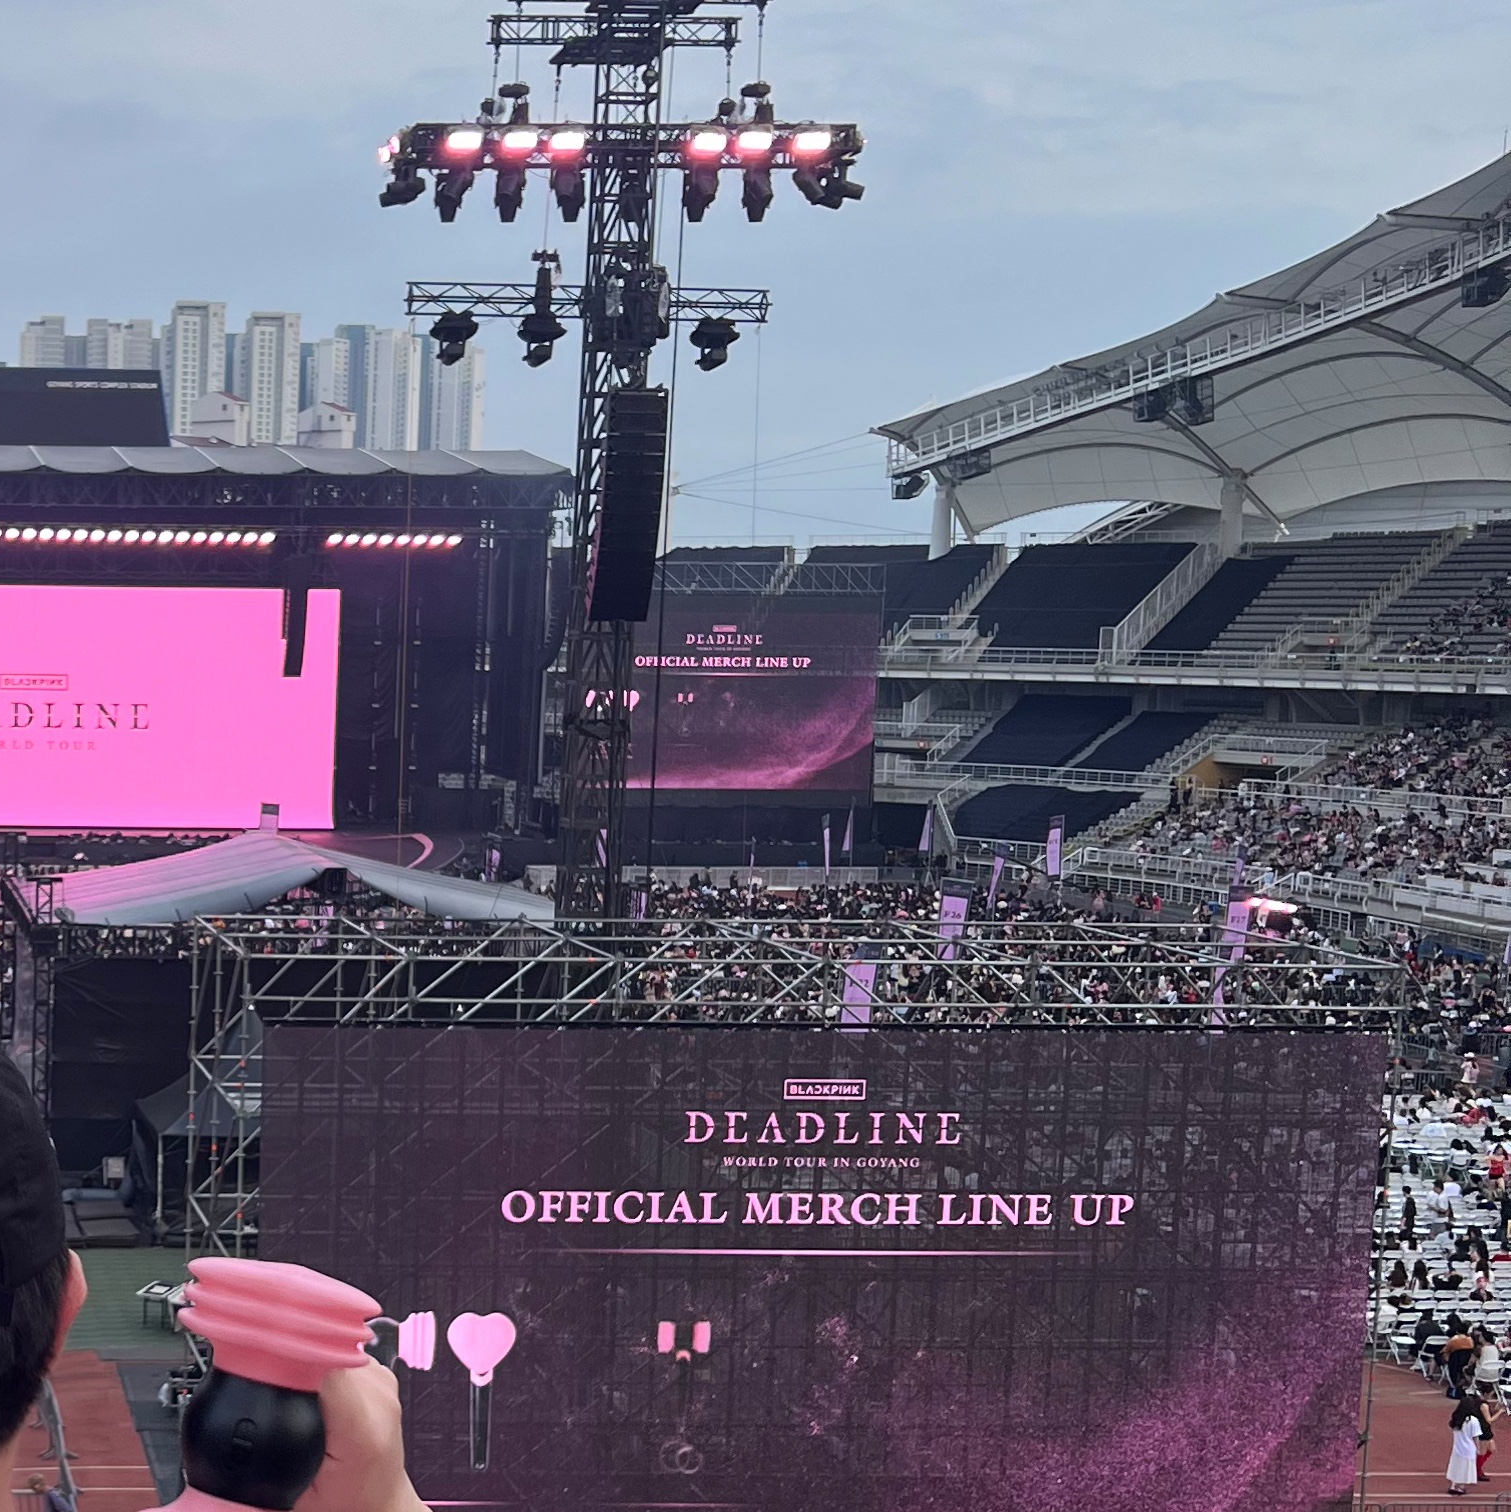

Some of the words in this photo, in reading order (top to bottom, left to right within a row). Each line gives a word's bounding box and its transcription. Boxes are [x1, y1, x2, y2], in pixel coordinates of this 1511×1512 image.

[685, 633, 763, 645] DEADLINE
[701, 656, 752, 668] MERCH
[755, 656, 789, 668] LINE
[792, 657, 811, 668] UP
[47, 741, 96, 751] TOUR
[943, 911, 962, 920] F26
[1230, 915, 1247, 924] F17
[789, 1084, 860, 1096] BLACKPINK
[683, 1111, 961, 1145] DEADLINE
[723, 1156, 779, 1167] WORLD
[784, 1156, 827, 1168] TOUR
[833, 1157, 850, 1168] IN
[856, 1157, 920, 1168] GOYANG
[500, 1190, 728, 1224] OFFICIAL
[741, 1192, 923, 1225] MERCH
[936, 1193, 1054, 1226] LINE
[1070, 1193, 1135, 1227] UP
